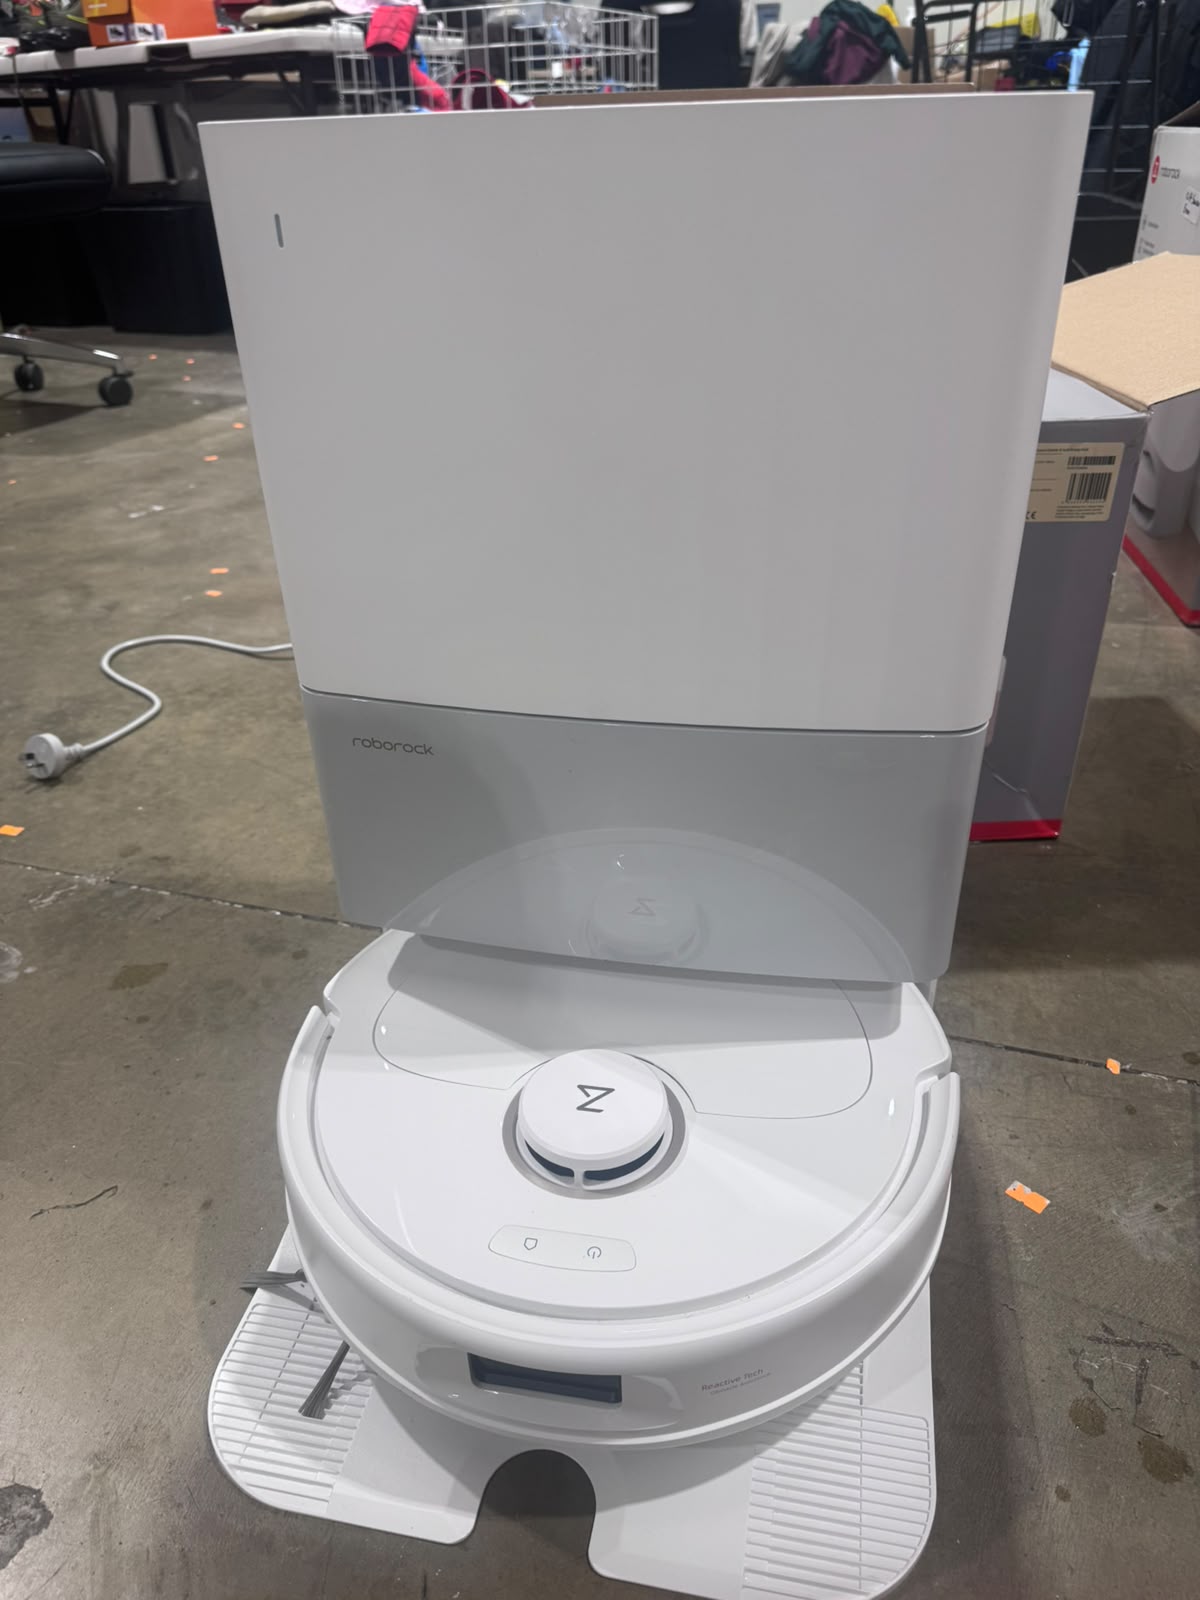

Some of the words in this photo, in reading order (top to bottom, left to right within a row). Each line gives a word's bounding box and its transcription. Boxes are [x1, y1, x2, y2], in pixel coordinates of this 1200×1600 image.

[352, 737, 434, 756] roborock
[701, 1376, 741, 1392] Reactive
[743, 1368, 764, 1380] Tech
